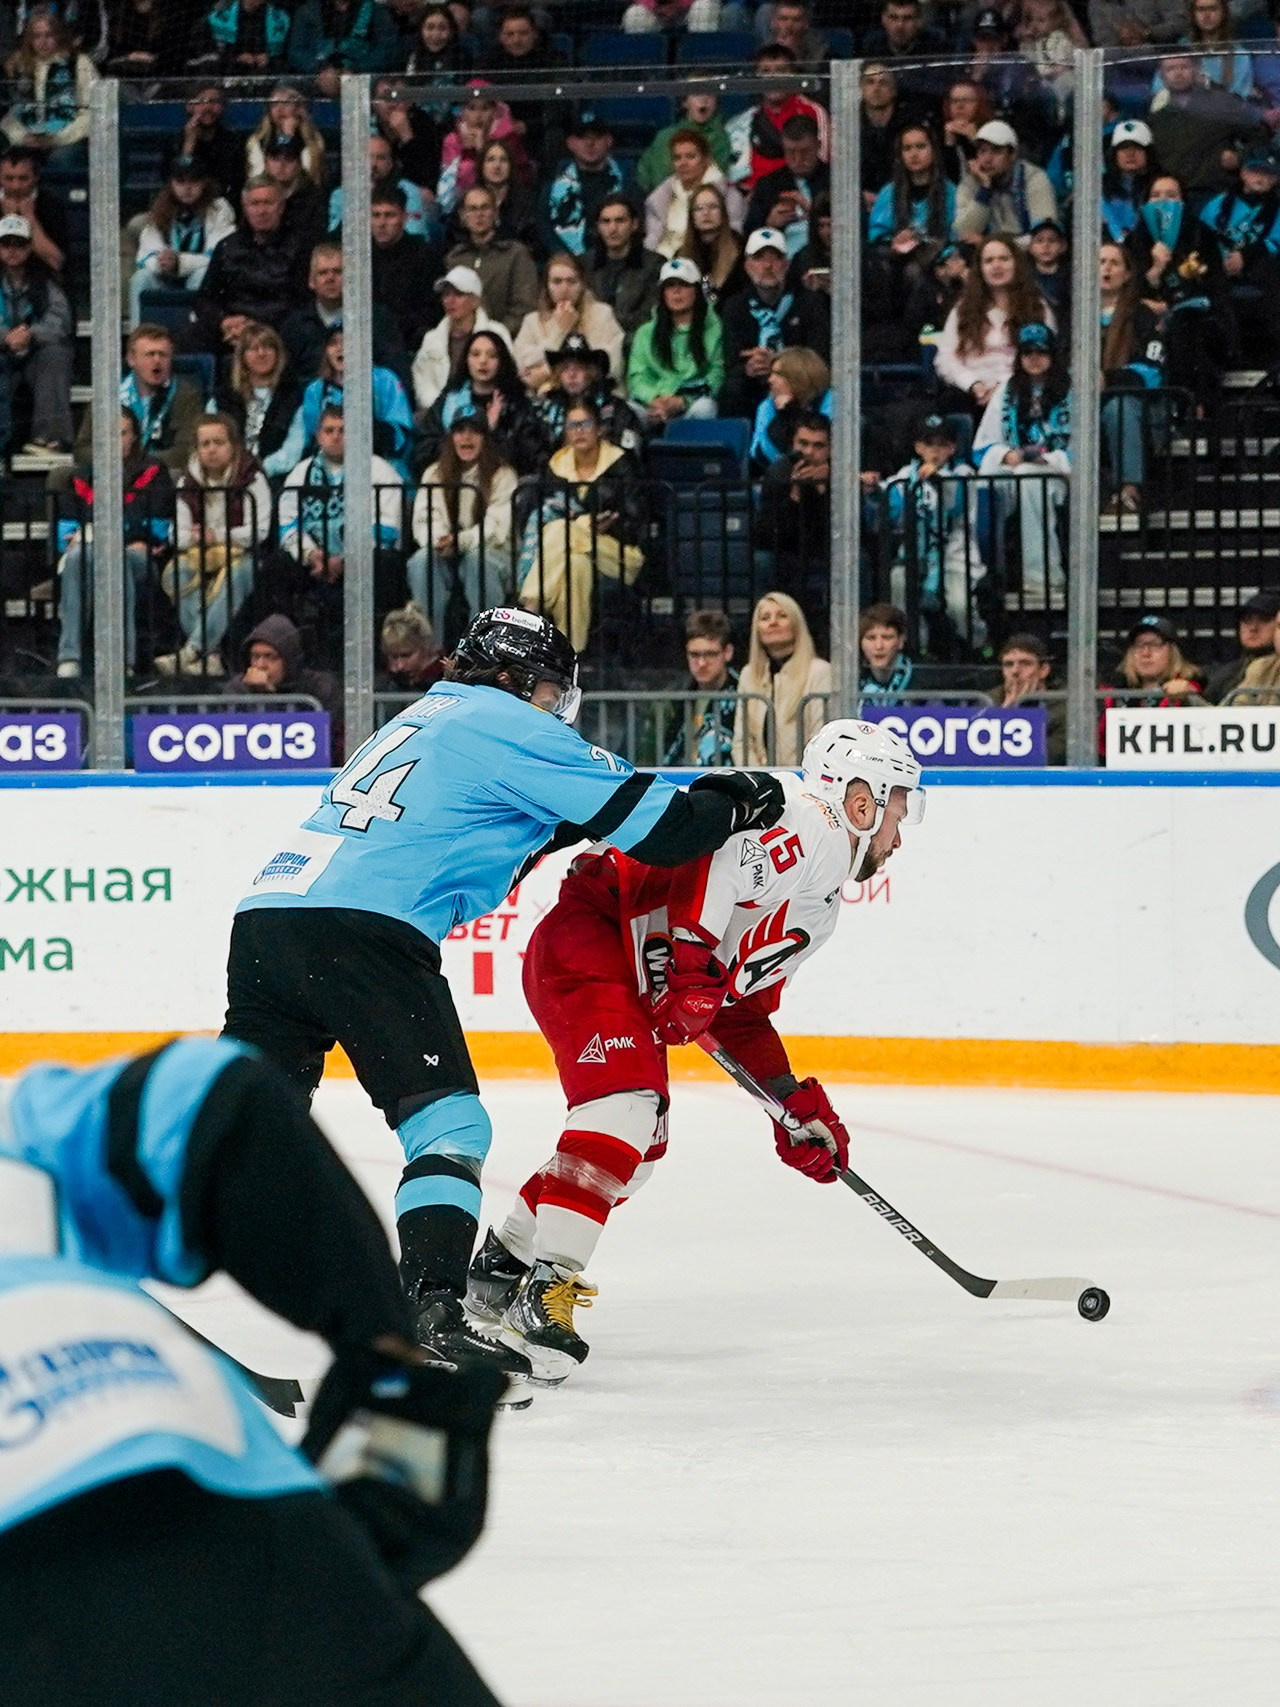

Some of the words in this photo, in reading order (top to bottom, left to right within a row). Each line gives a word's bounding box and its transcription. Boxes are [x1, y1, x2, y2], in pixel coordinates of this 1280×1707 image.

[148, 722, 316, 763] согаз
[1118, 722, 1277, 755] KHL.RU
[329, 723, 424, 834] 4
[758, 826, 805, 874] 15
[0, 867, 172, 902] жная
[840, 869, 891, 904] ОЙ
